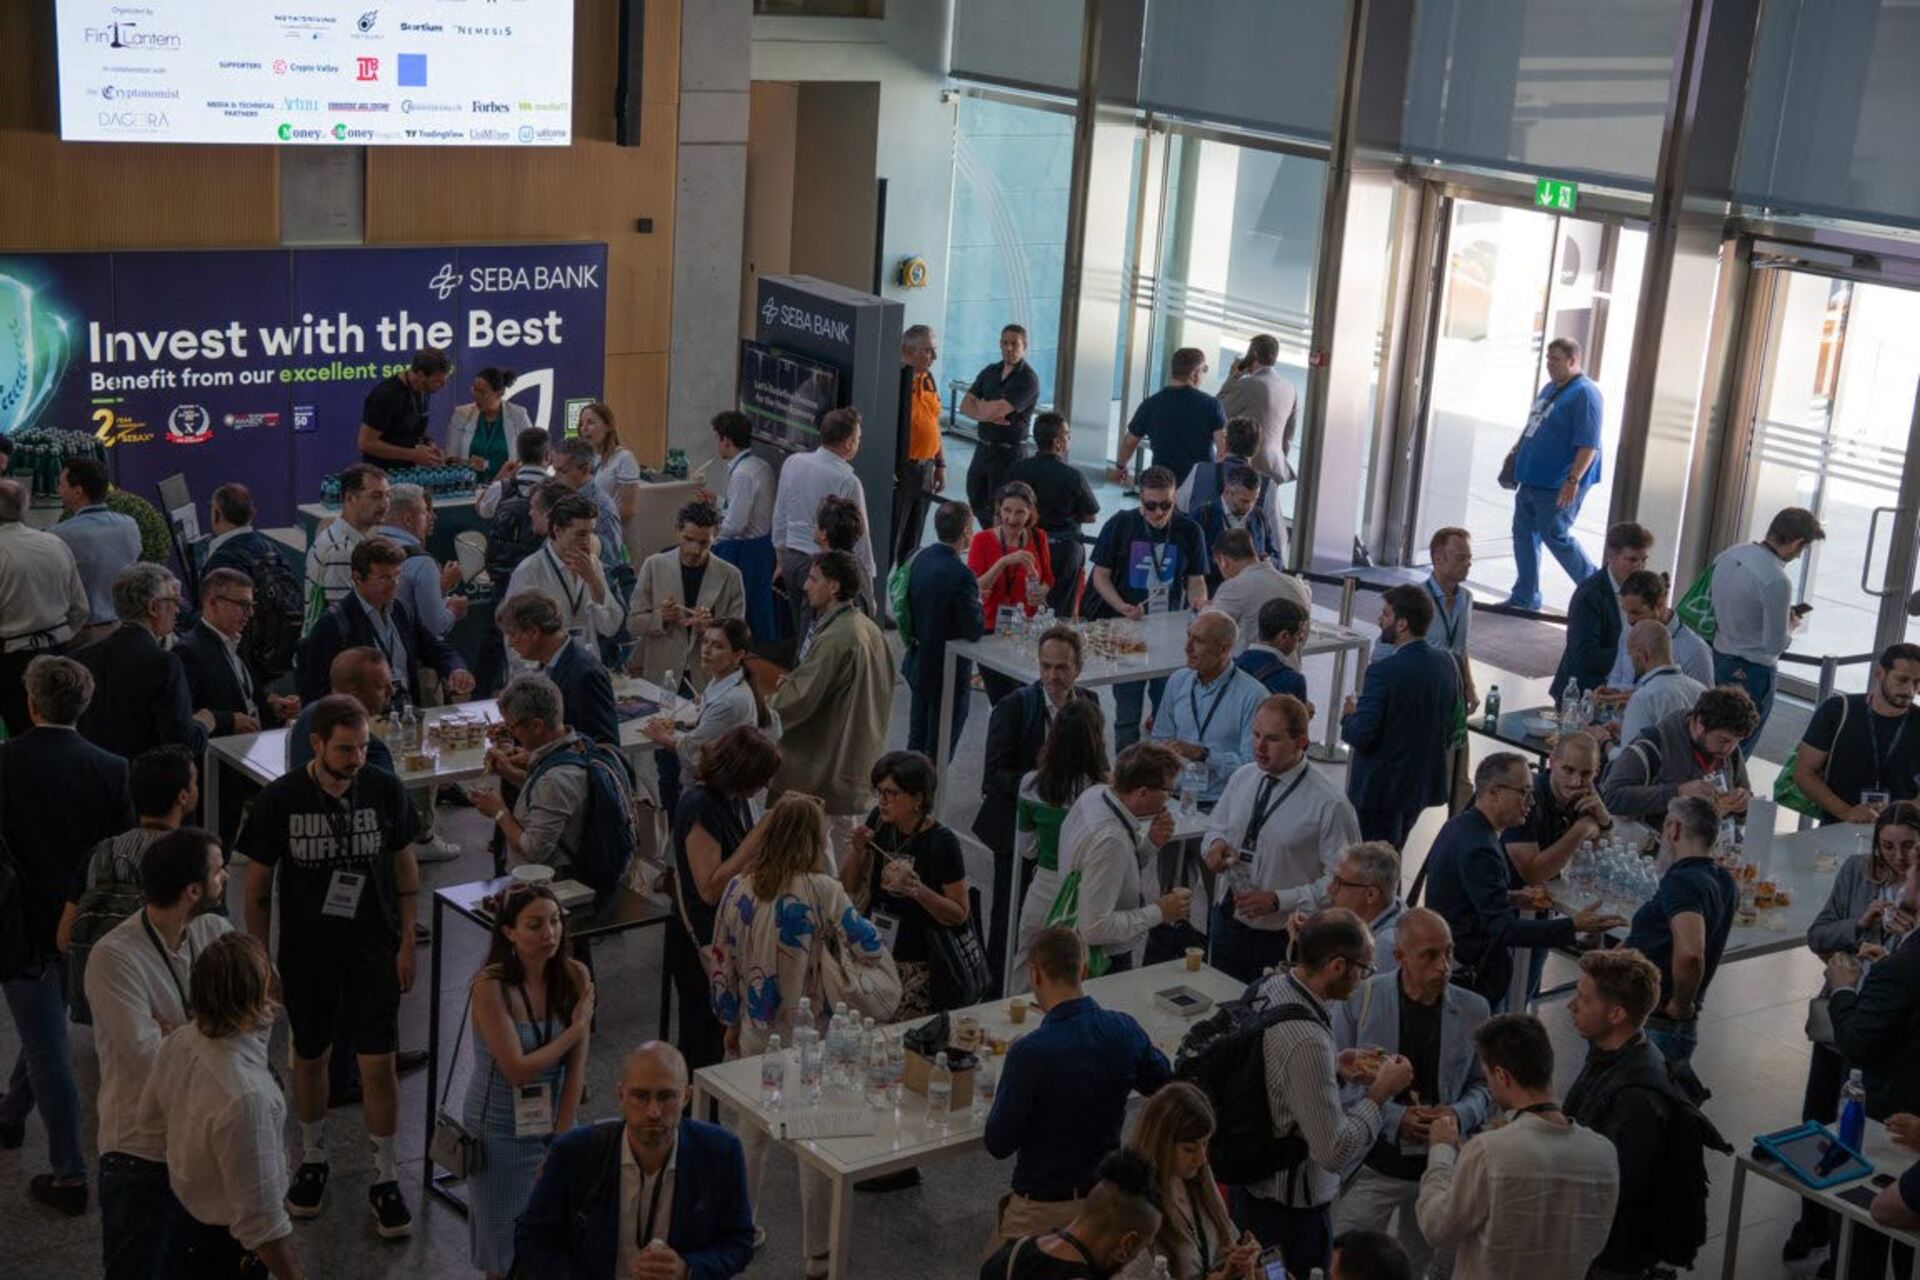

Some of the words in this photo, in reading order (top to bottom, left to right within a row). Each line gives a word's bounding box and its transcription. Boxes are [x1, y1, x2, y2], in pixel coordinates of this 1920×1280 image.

[219, 61, 262, 69] SUPPORTERS
[290, 62, 315, 73] Crypto
[316, 64, 339, 73] Valley
[239, 102, 275, 110] TECHNICAL
[472, 101, 510, 113] Forbes
[223, 110, 259, 118] PARTNERS
[470, 267, 531, 292] SEBA
[534, 264, 599, 290] BANK
[781, 304, 812, 332] SEBA
[813, 314, 850, 345] BANK
[89, 321, 248, 363] Invest
[259, 312, 365, 356] with
[376, 310, 454, 352] the
[468, 309, 563, 347] Best
[91, 368, 176, 391] Benefit
[181, 367, 234, 387] from
[239, 369, 275, 385] our
[279, 361, 377, 383] excellent
[294, 415, 308, 426] 50
